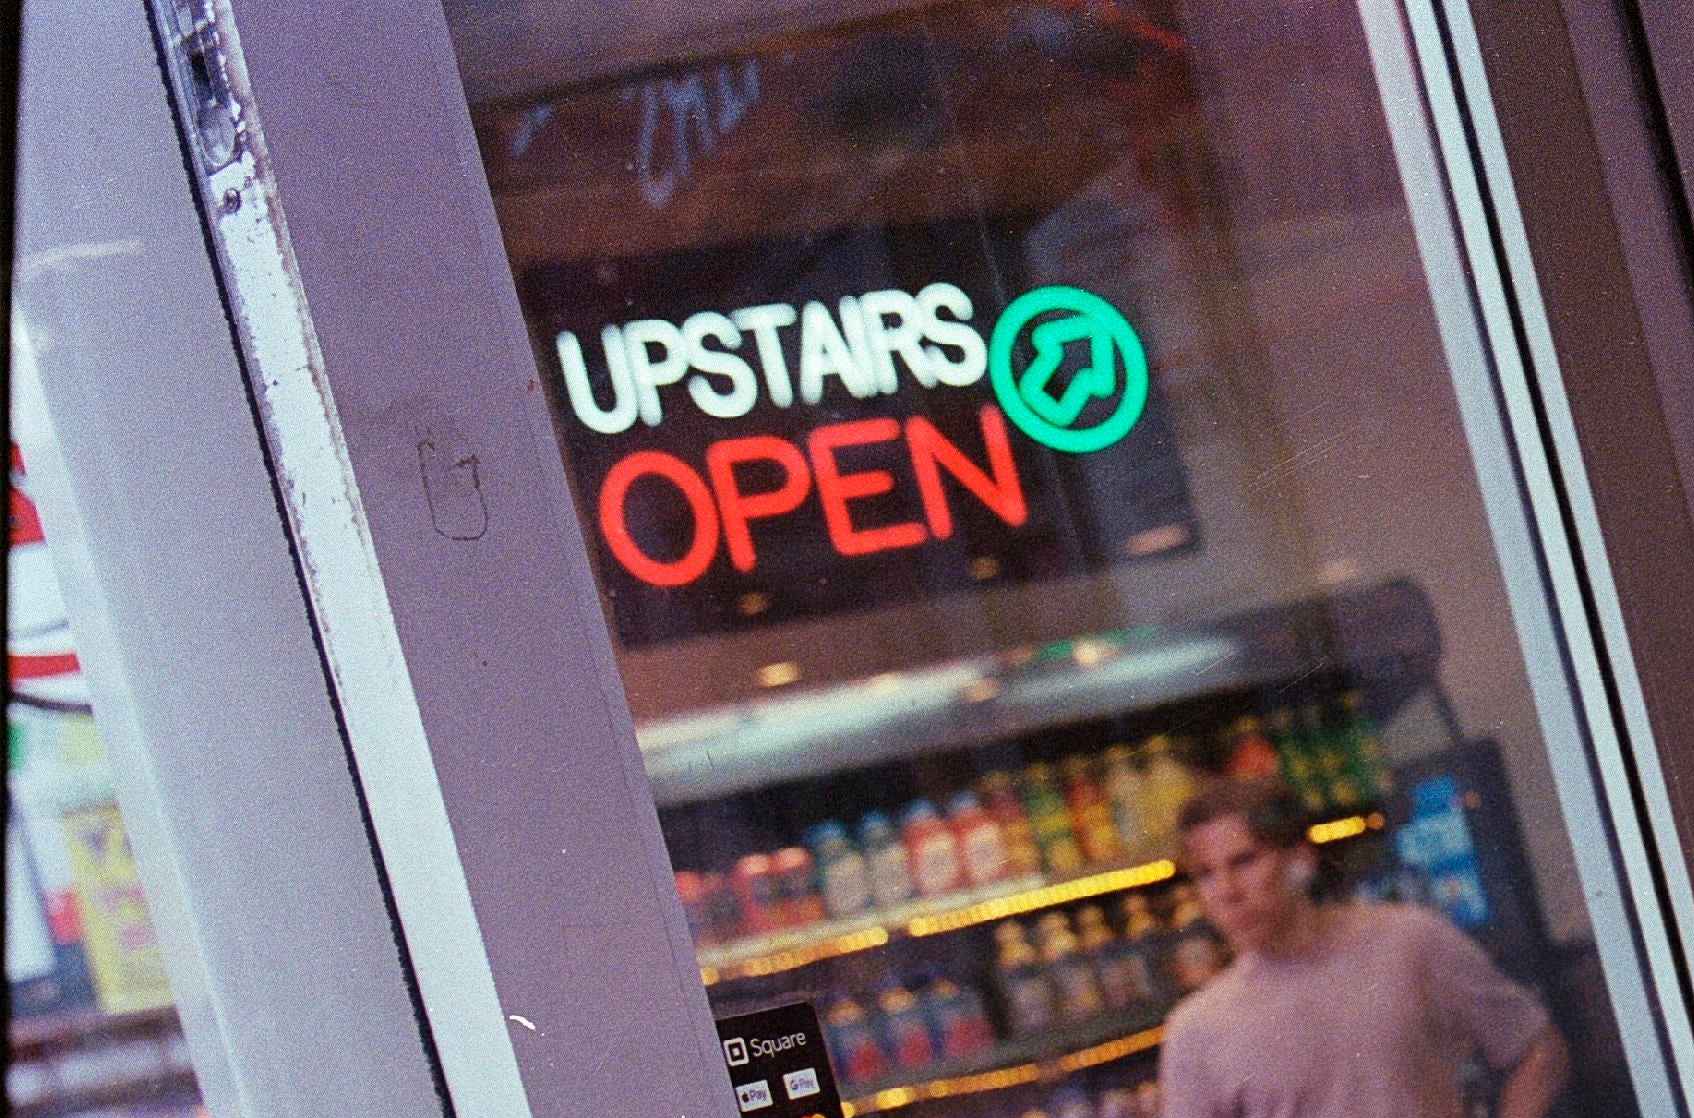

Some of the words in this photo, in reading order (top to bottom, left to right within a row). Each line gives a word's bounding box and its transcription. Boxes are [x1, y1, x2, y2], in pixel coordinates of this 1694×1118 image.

[557, 282, 988, 434] UPSTAIRS
[600, 405, 1026, 586] OPEN
[751, 1031, 807, 1058] Square
